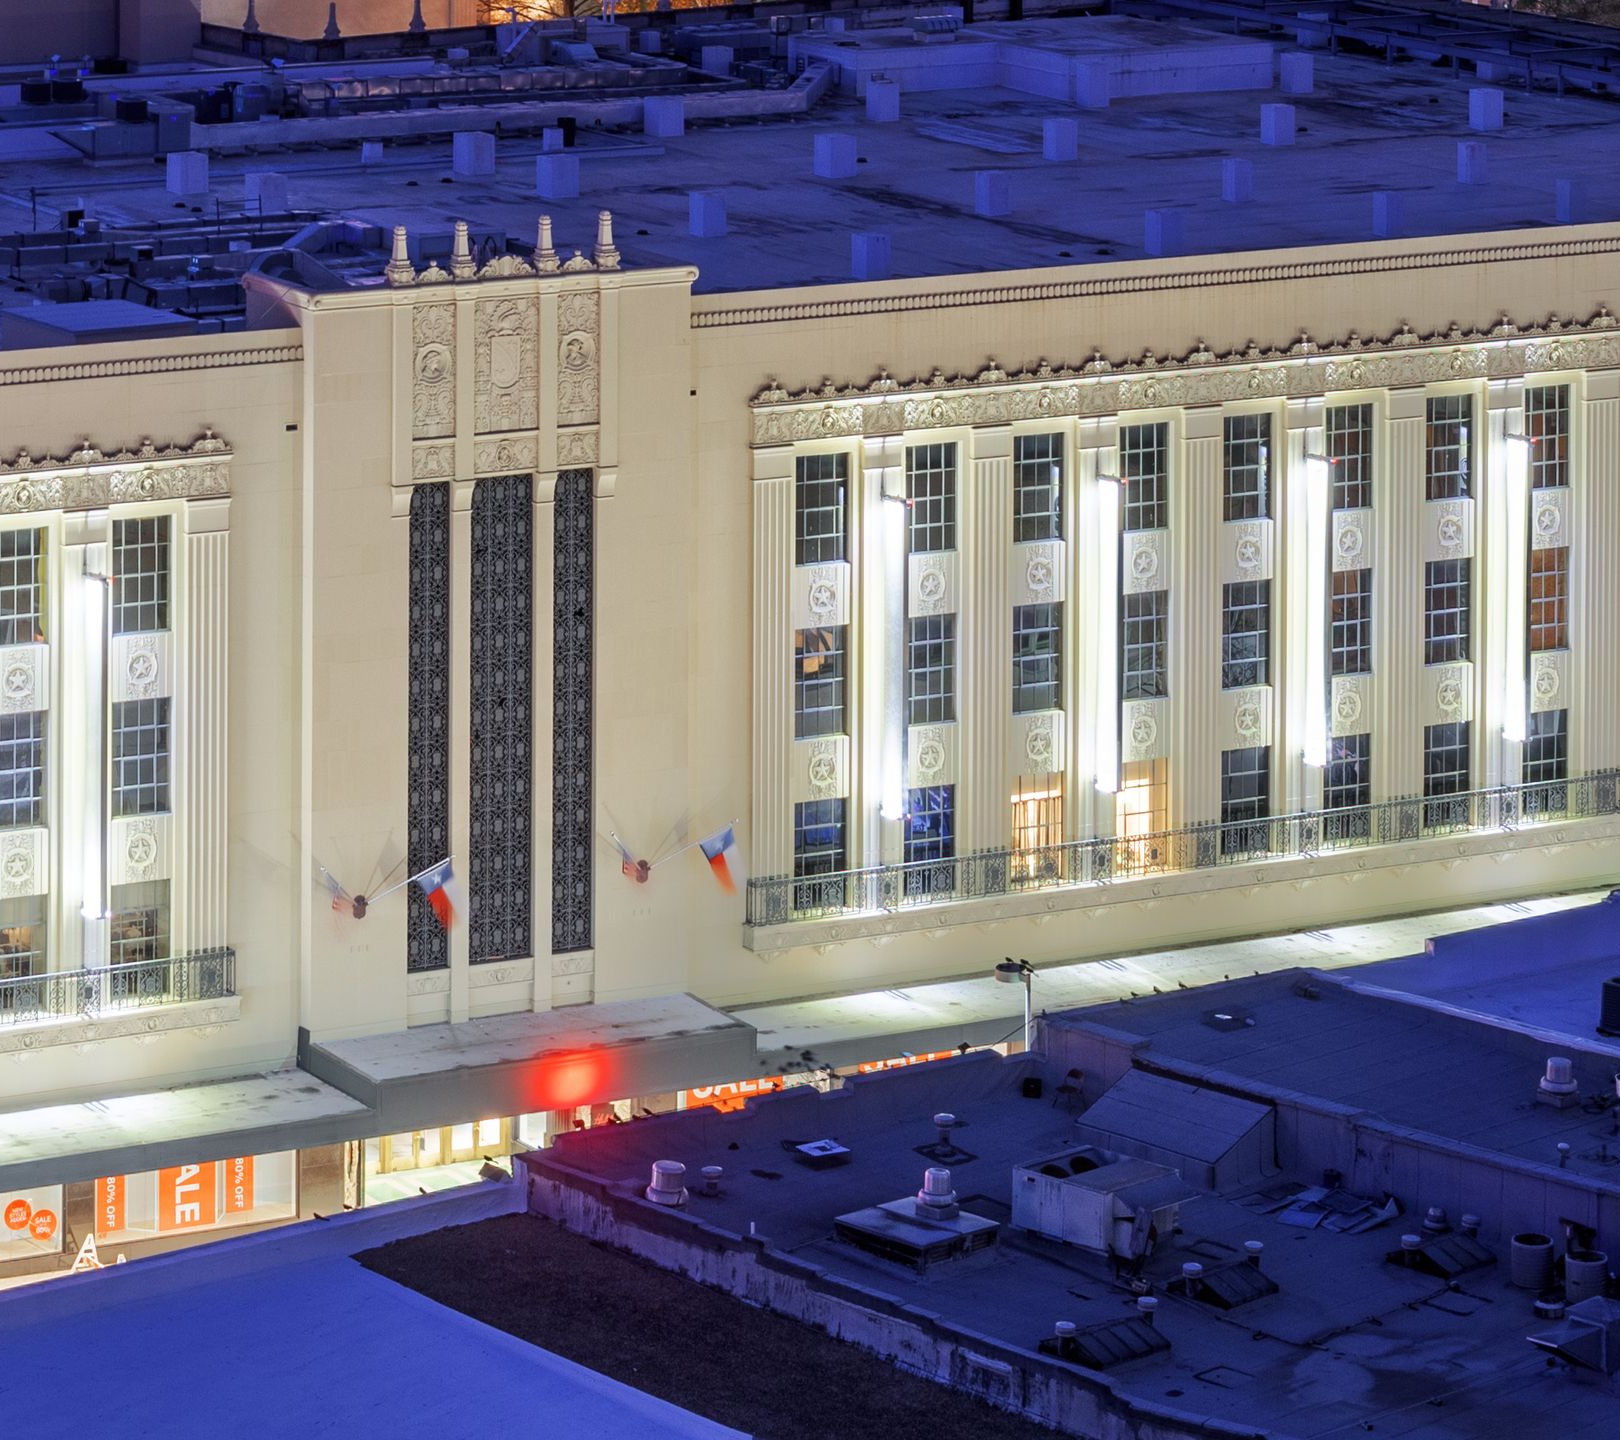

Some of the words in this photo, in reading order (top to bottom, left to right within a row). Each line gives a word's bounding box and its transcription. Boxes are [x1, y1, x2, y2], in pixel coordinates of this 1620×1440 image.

[234, 1157, 245, 1184] 80%
[106, 1176, 116, 1203] 80%
[234, 1186, 245, 1208] OFF
[35, 1215, 52, 1224] SALE
[106, 1206, 116, 1228] OFF
